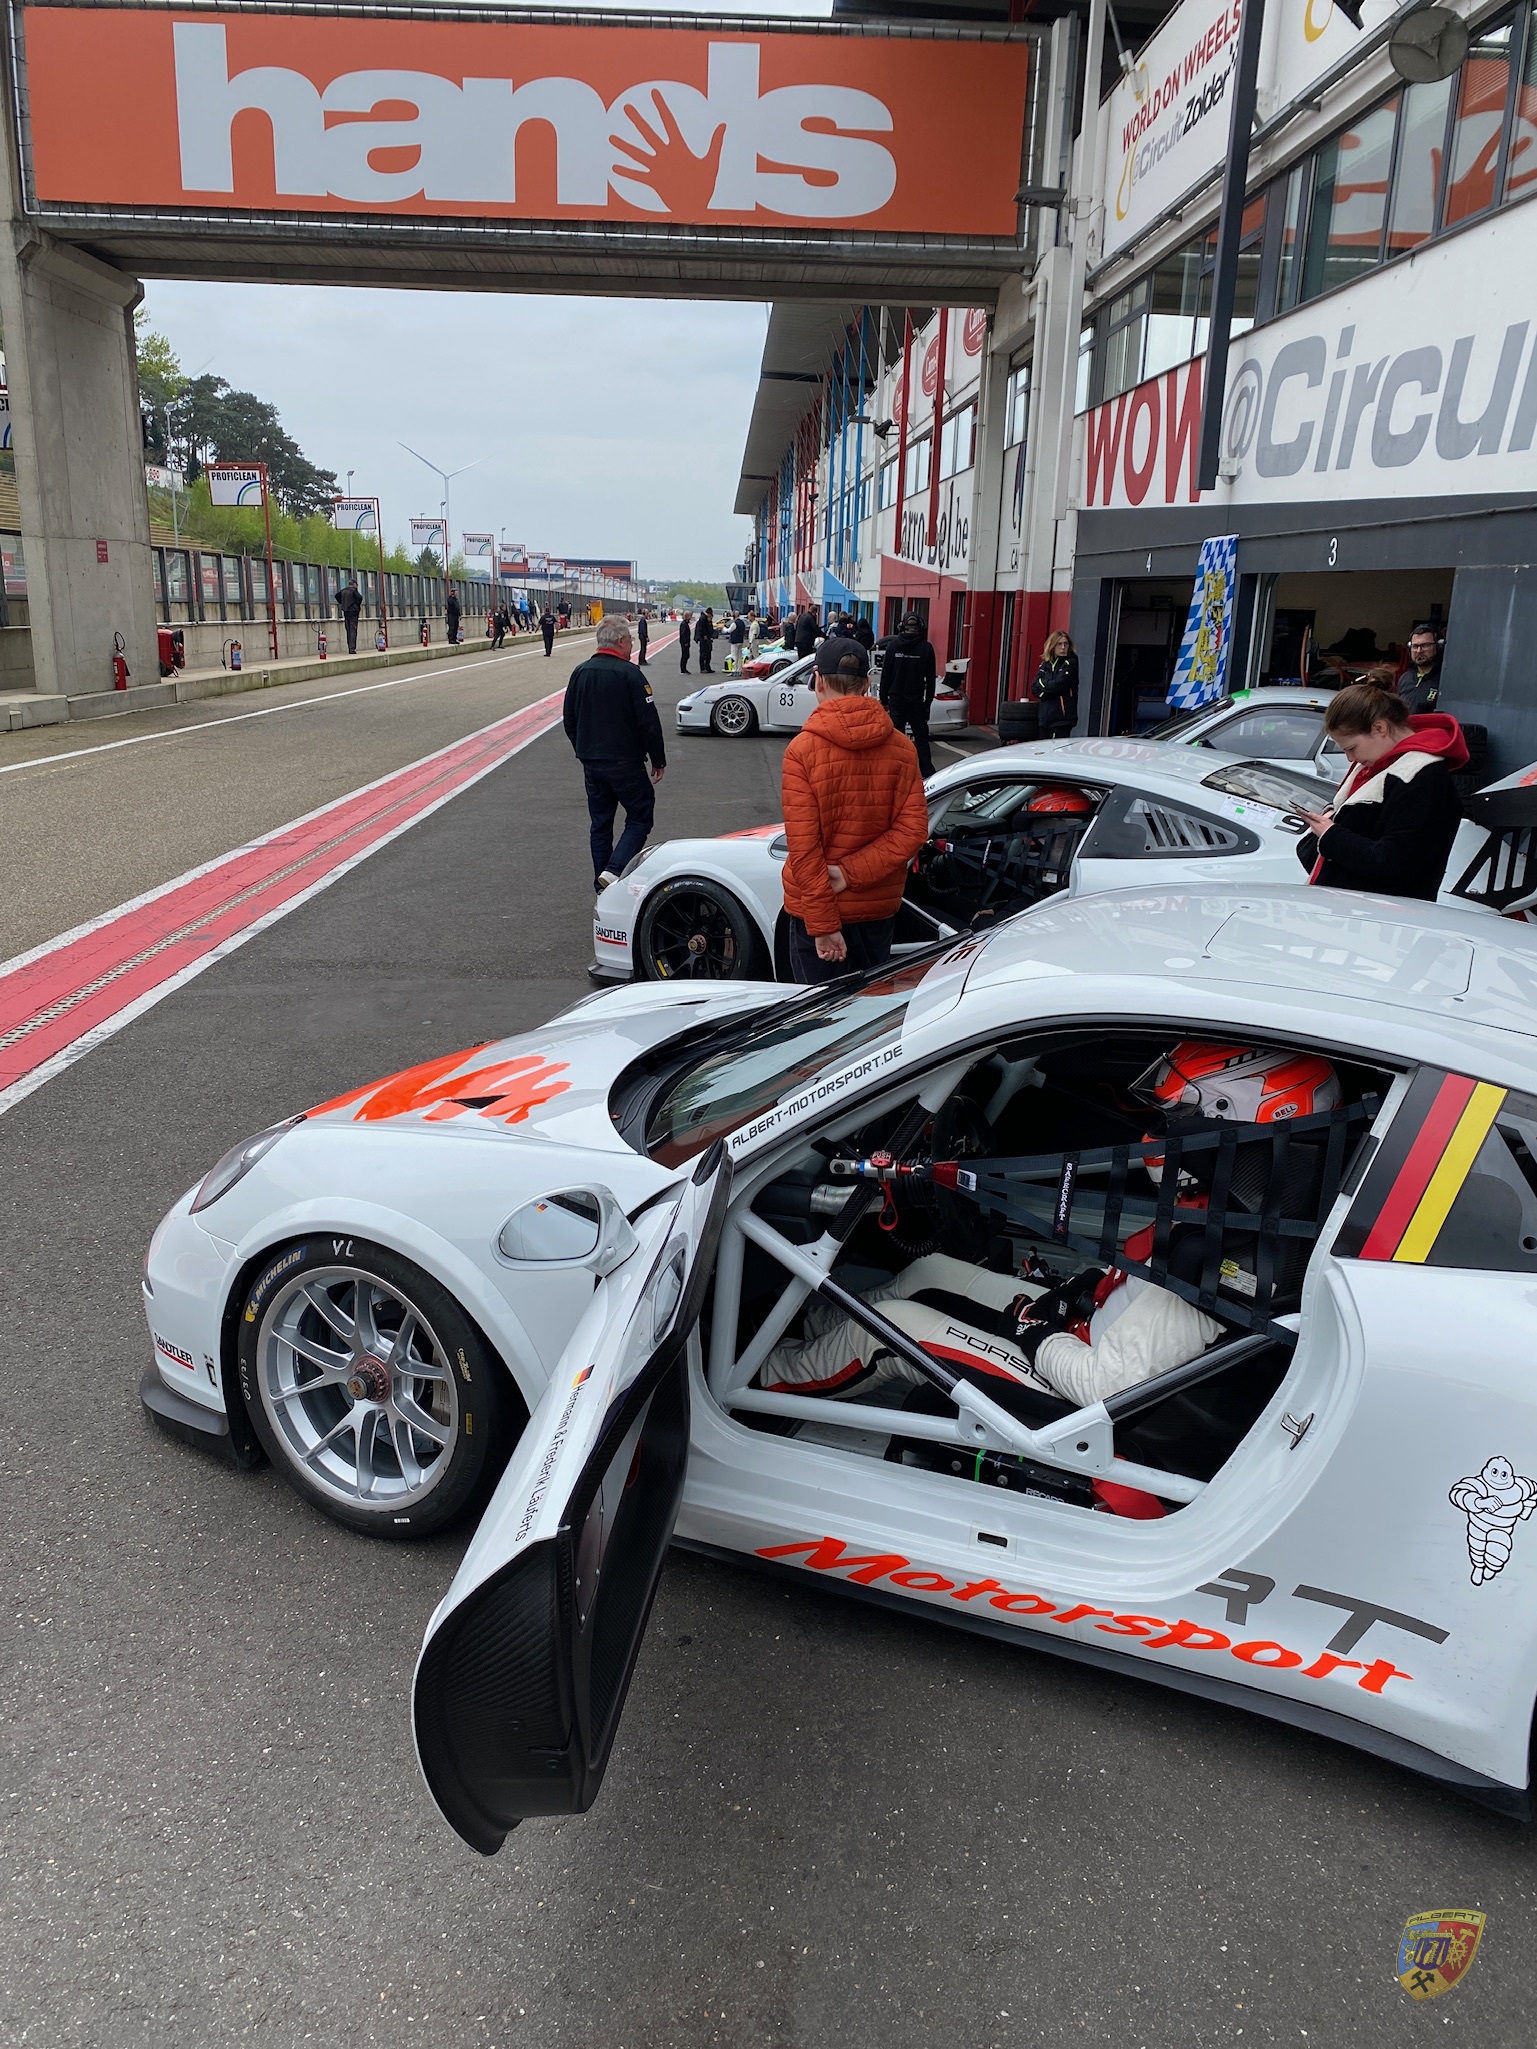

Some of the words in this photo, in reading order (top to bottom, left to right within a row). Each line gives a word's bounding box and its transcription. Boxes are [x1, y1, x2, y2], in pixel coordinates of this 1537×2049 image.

[1122, 92, 1161, 155] WORLD
[1162, 63, 1182, 110] ON
[1184, 0, 1242, 87] WHEELS
[172, 22, 897, 218] hands
[211, 471, 257, 481] PROFICLEAN
[336, 503, 372, 511] PROFICLEAN
[1145, 553, 1153, 573] 4
[1328, 537, 1339, 566] 3
[779, 692, 794, 707] 83
[595, 925, 628, 942] SANDTLER
[731, 1044, 903, 1149] ALBERT-MOTORSPORT.DE
[1274, 1105, 1298, 1118] BELL
[871, 1150, 892, 1160] PUSH
[1058, 1162, 1074, 1221] SAFECRAFT
[255, 1250, 302, 1301] MICHELIN
[556, 1383, 585, 1431] Hermann
[534, 1439, 564, 1488] Frederik
[754, 1536, 1414, 1694] Motorsport
